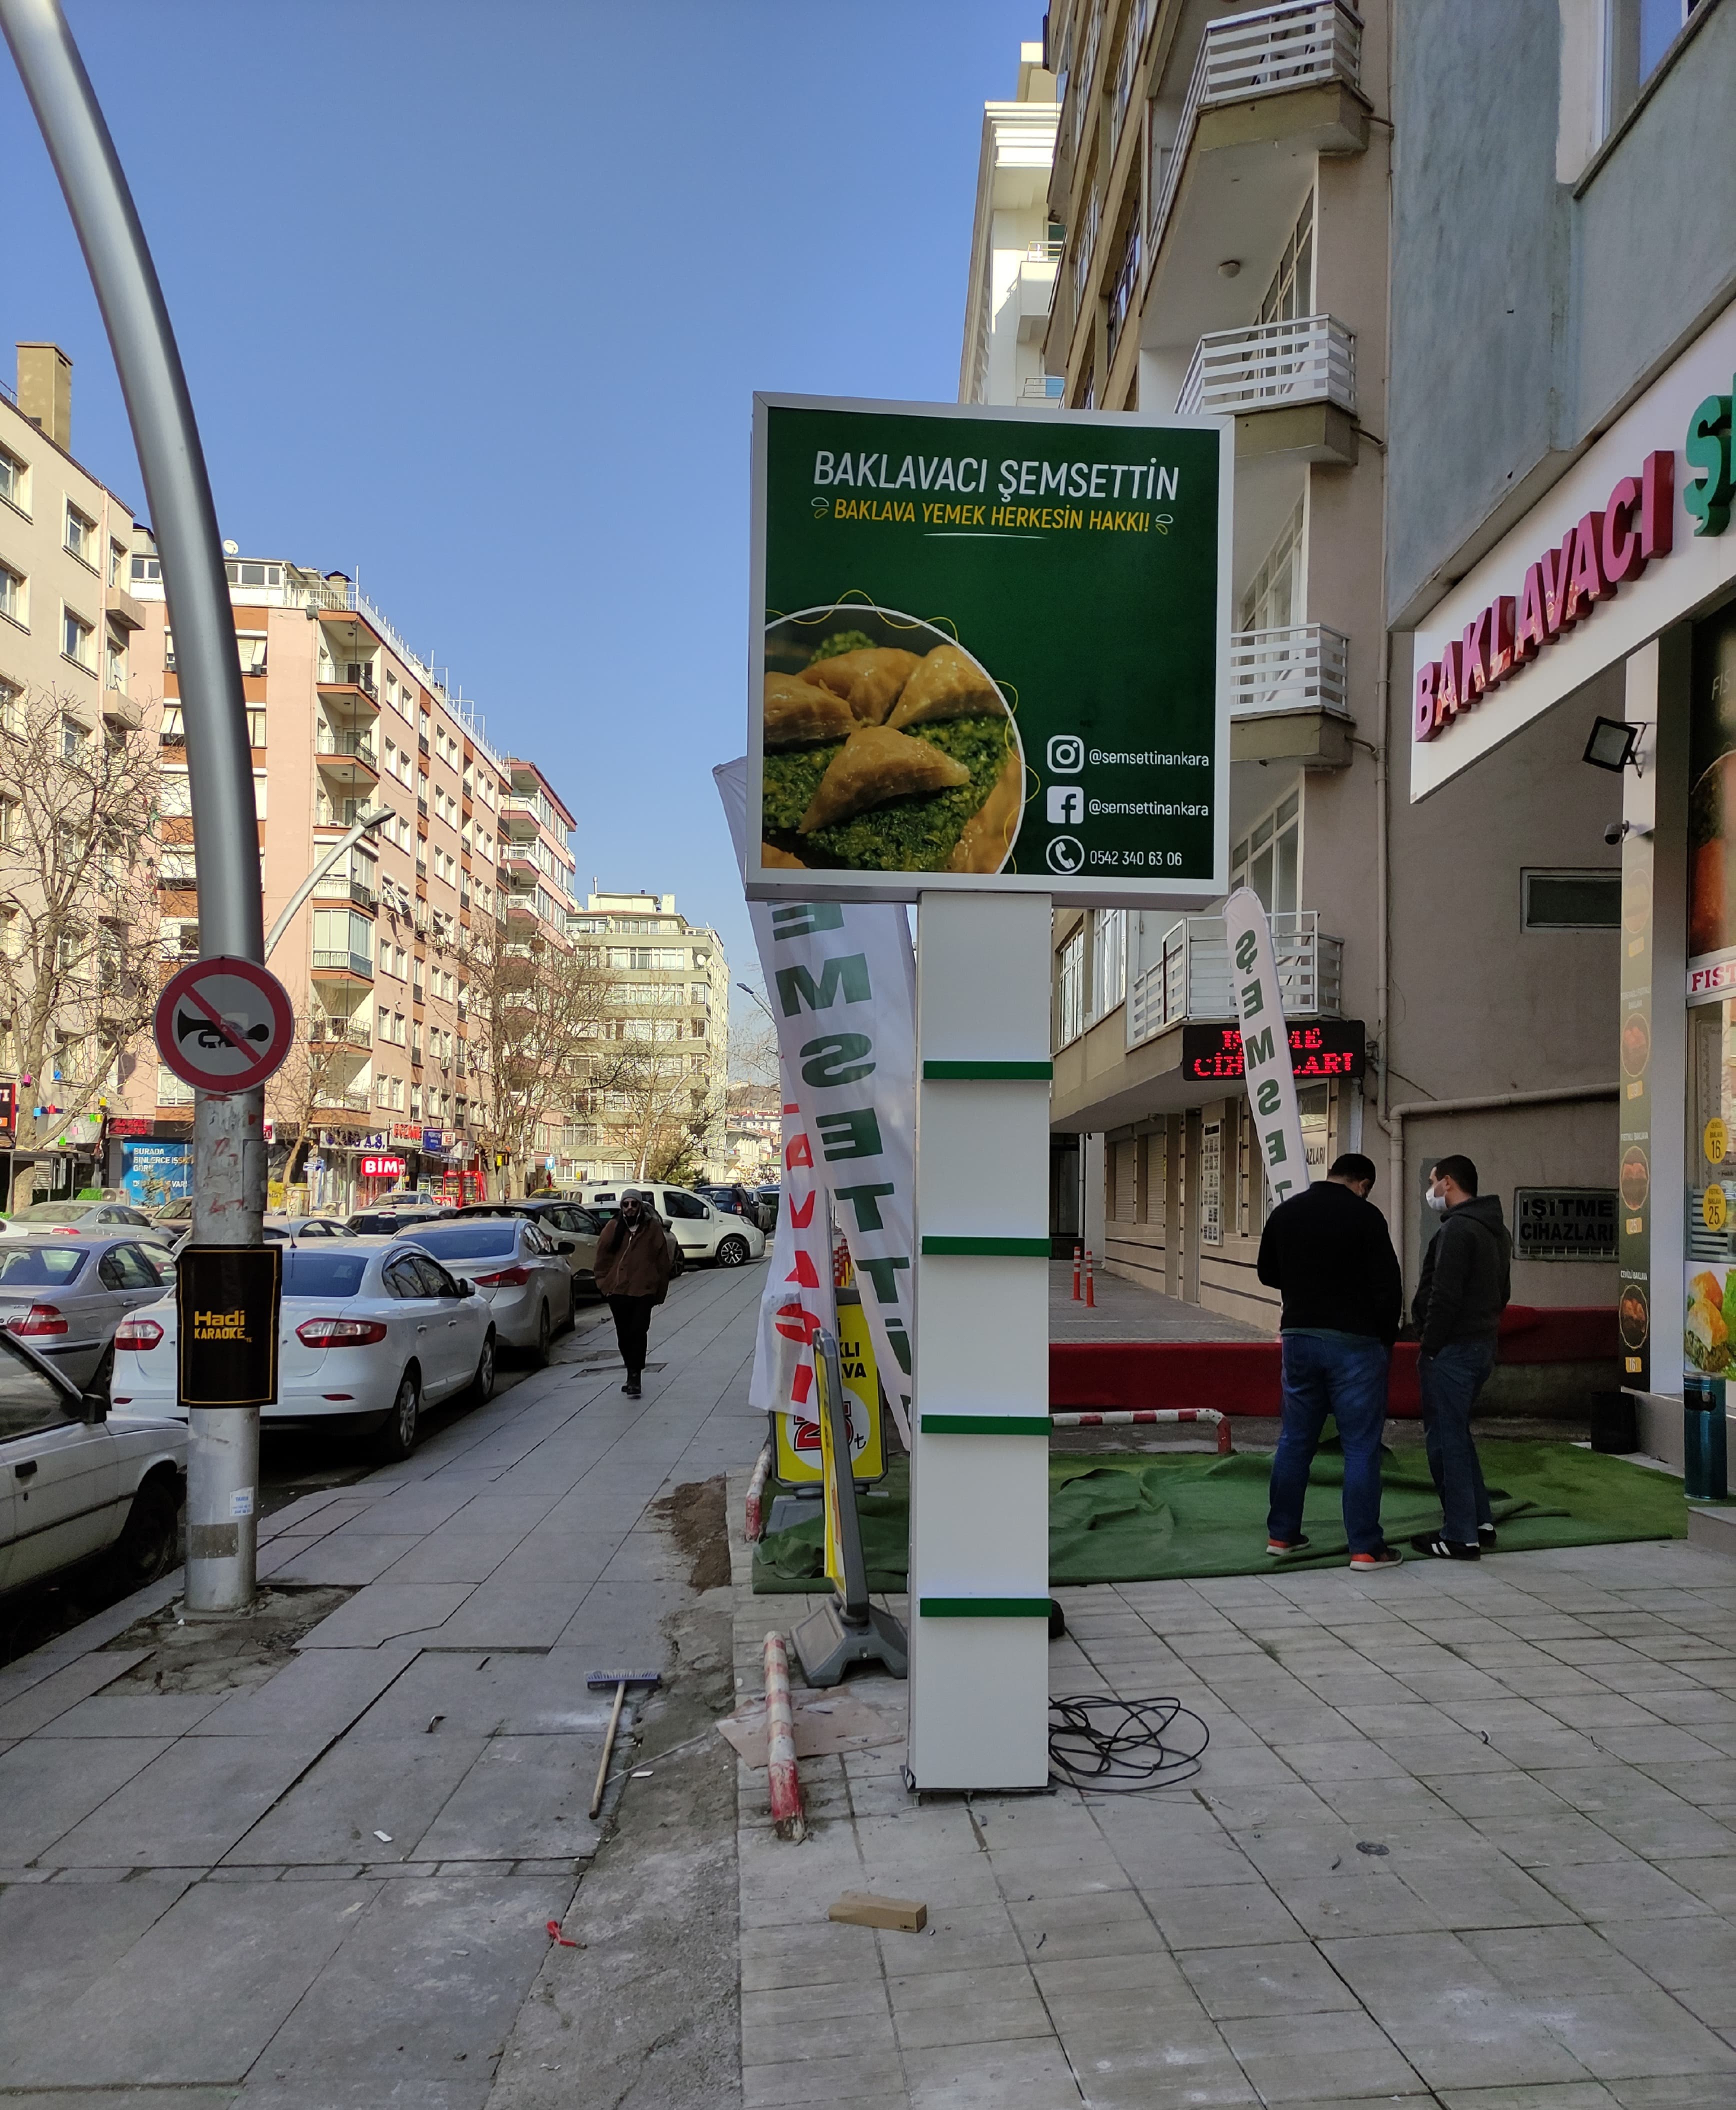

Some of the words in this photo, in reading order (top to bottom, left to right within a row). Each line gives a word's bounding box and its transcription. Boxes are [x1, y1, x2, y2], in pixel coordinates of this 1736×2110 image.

[814, 450, 988, 492] BAKLAVACI
[998, 458, 1179, 502] ŞEMSETTİN
[834, 499, 916, 522] BAKLAVA
[922, 503, 986, 525] YEMEK
[991, 504, 1083, 529] HERKESİN
[1090, 510, 1150, 532] HAKKI!
[1415, 450, 1674, 742] BAKLAVACI
[1089, 749, 1209, 766] @semsettinankara
[1089, 799, 1208, 816] @semsettinankara
[1090, 850, 1118, 864] 0542
[1122, 851, 1144, 865] 340
[1149, 852, 1162, 866] 63
[1167, 852, 1182, 866] 06
[1712, 1140, 1720, 1158] 16
[365, 1158, 398, 1174] BİM
[1708, 1206, 1720, 1224] 25
[194, 1310, 245, 1326] Hadi
[194, 1328, 246, 1340] KARAOKE
